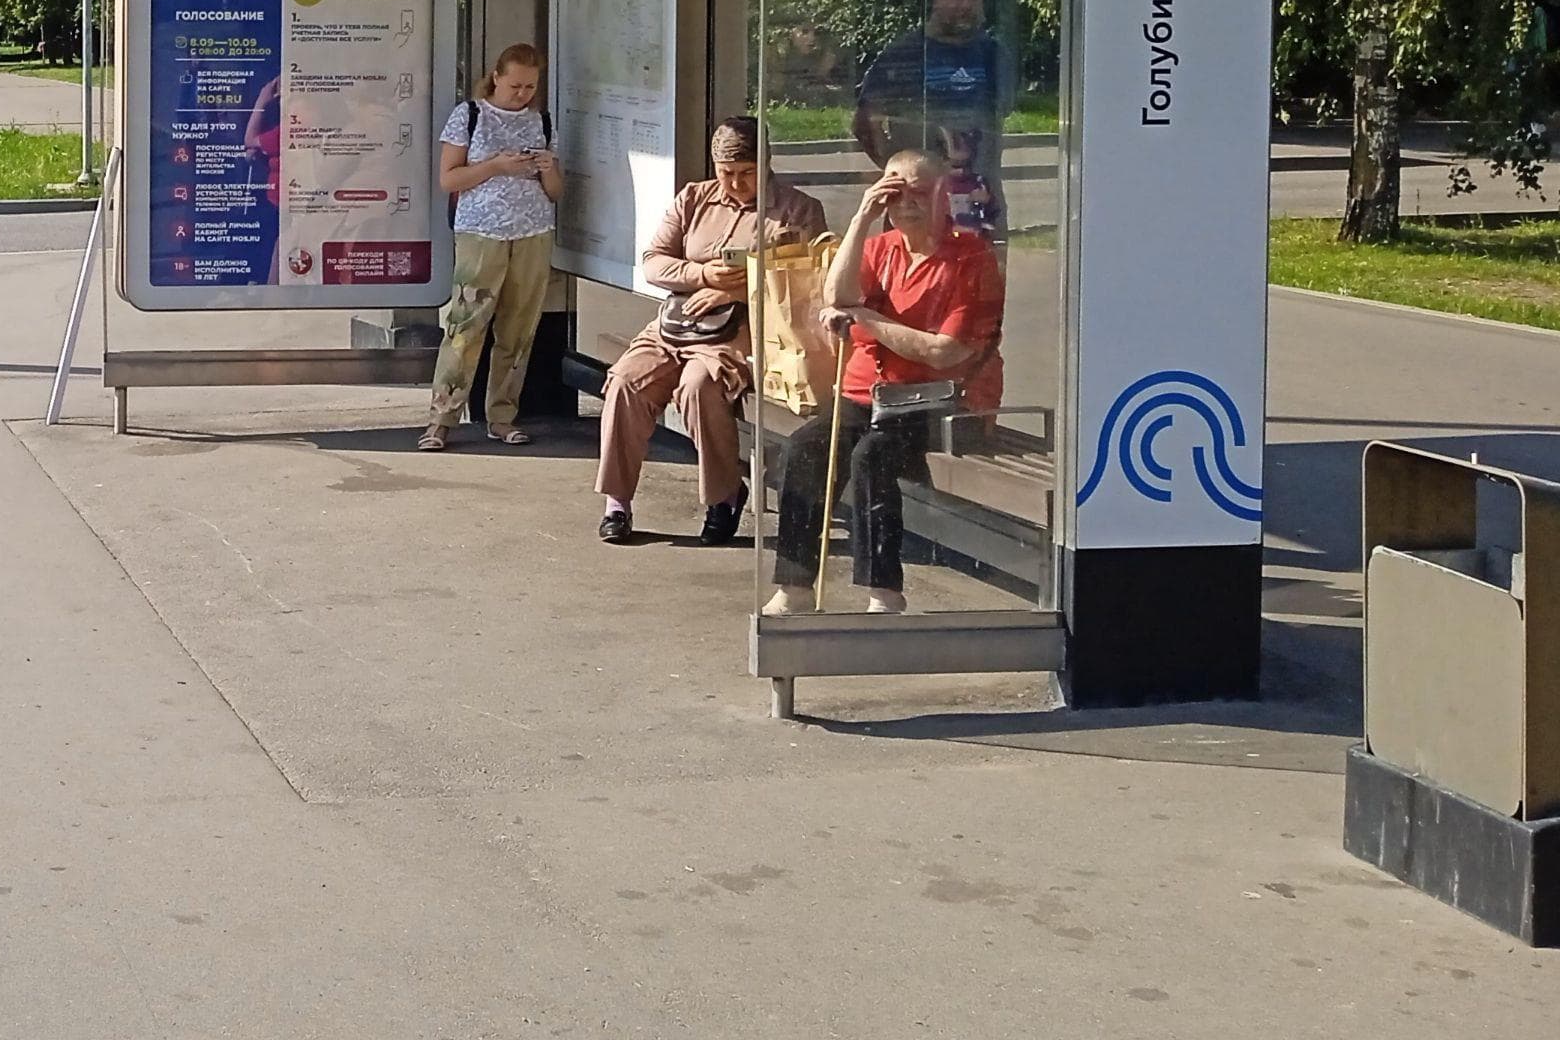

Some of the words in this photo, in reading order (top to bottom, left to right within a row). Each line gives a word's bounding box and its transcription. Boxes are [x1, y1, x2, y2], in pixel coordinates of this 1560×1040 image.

[175, 11, 264, 20] ГОЛОСОВАНИЕ
[291, 12, 300, 22] 1.
[228, 48, 242, 56] ДО
[290, 63, 302, 73] 2.
[197, 95, 242, 104] MOS.RU
[290, 115, 301, 124] 3.
[191, 123, 208, 131] ДЛЯ
[172, 132, 209, 140] НУЖНО?
[289, 179, 301, 188] 4.
